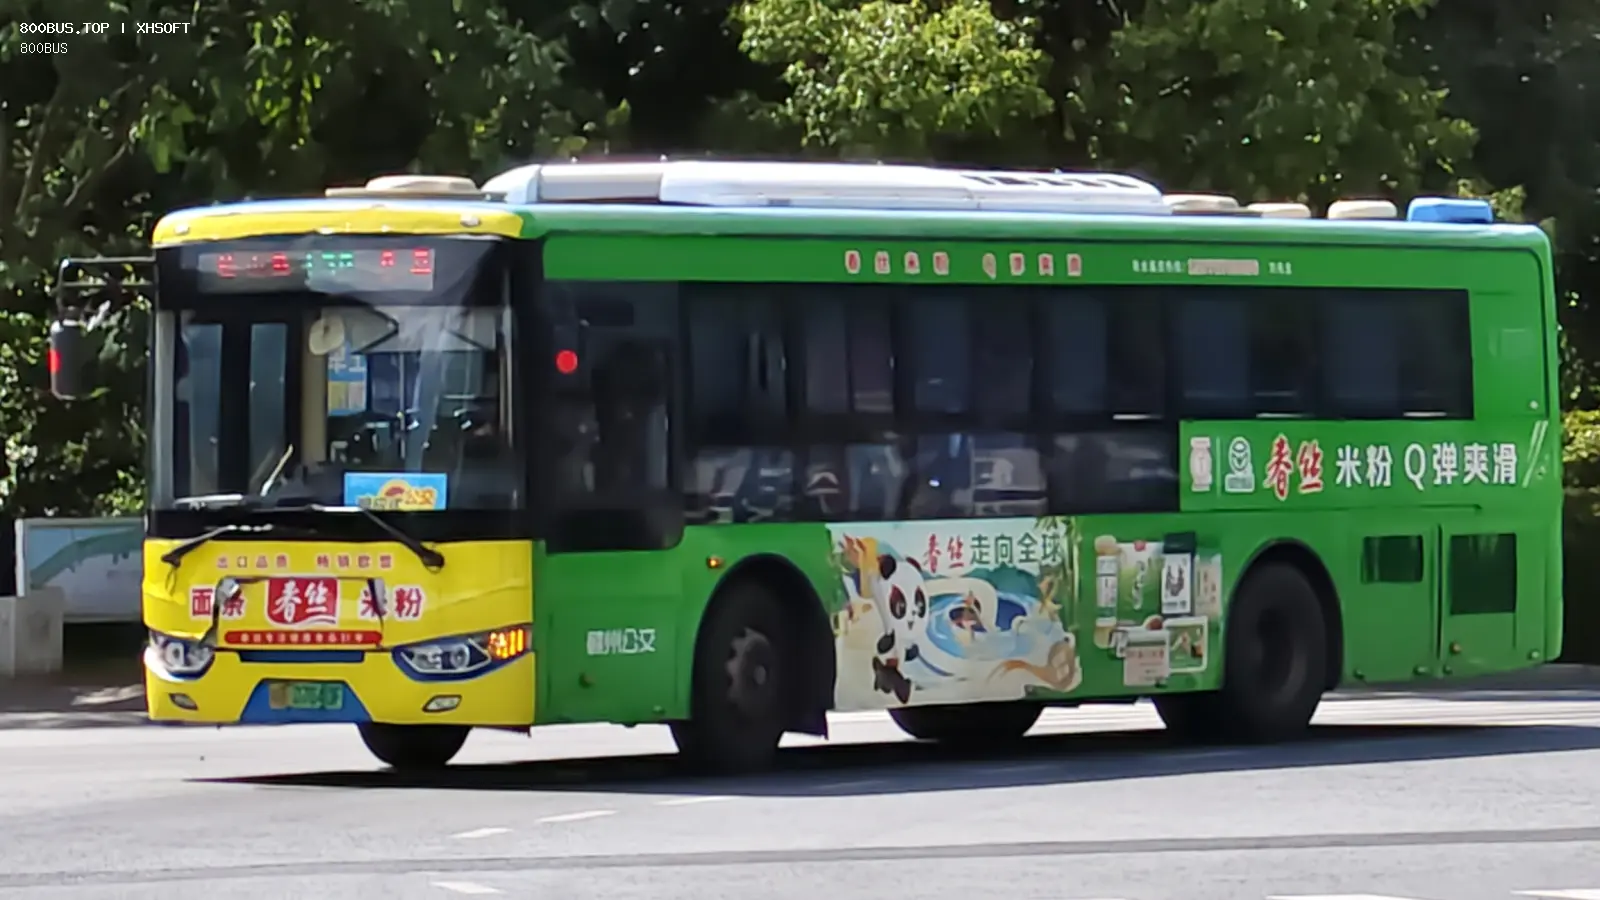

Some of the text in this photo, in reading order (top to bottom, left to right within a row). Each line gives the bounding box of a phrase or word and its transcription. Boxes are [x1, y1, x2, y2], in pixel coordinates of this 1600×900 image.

[1335, 444, 1393, 487] 米粉
[1403, 442, 1518, 491] Q弹爽滑
[361, 587, 422, 618] 米粉
